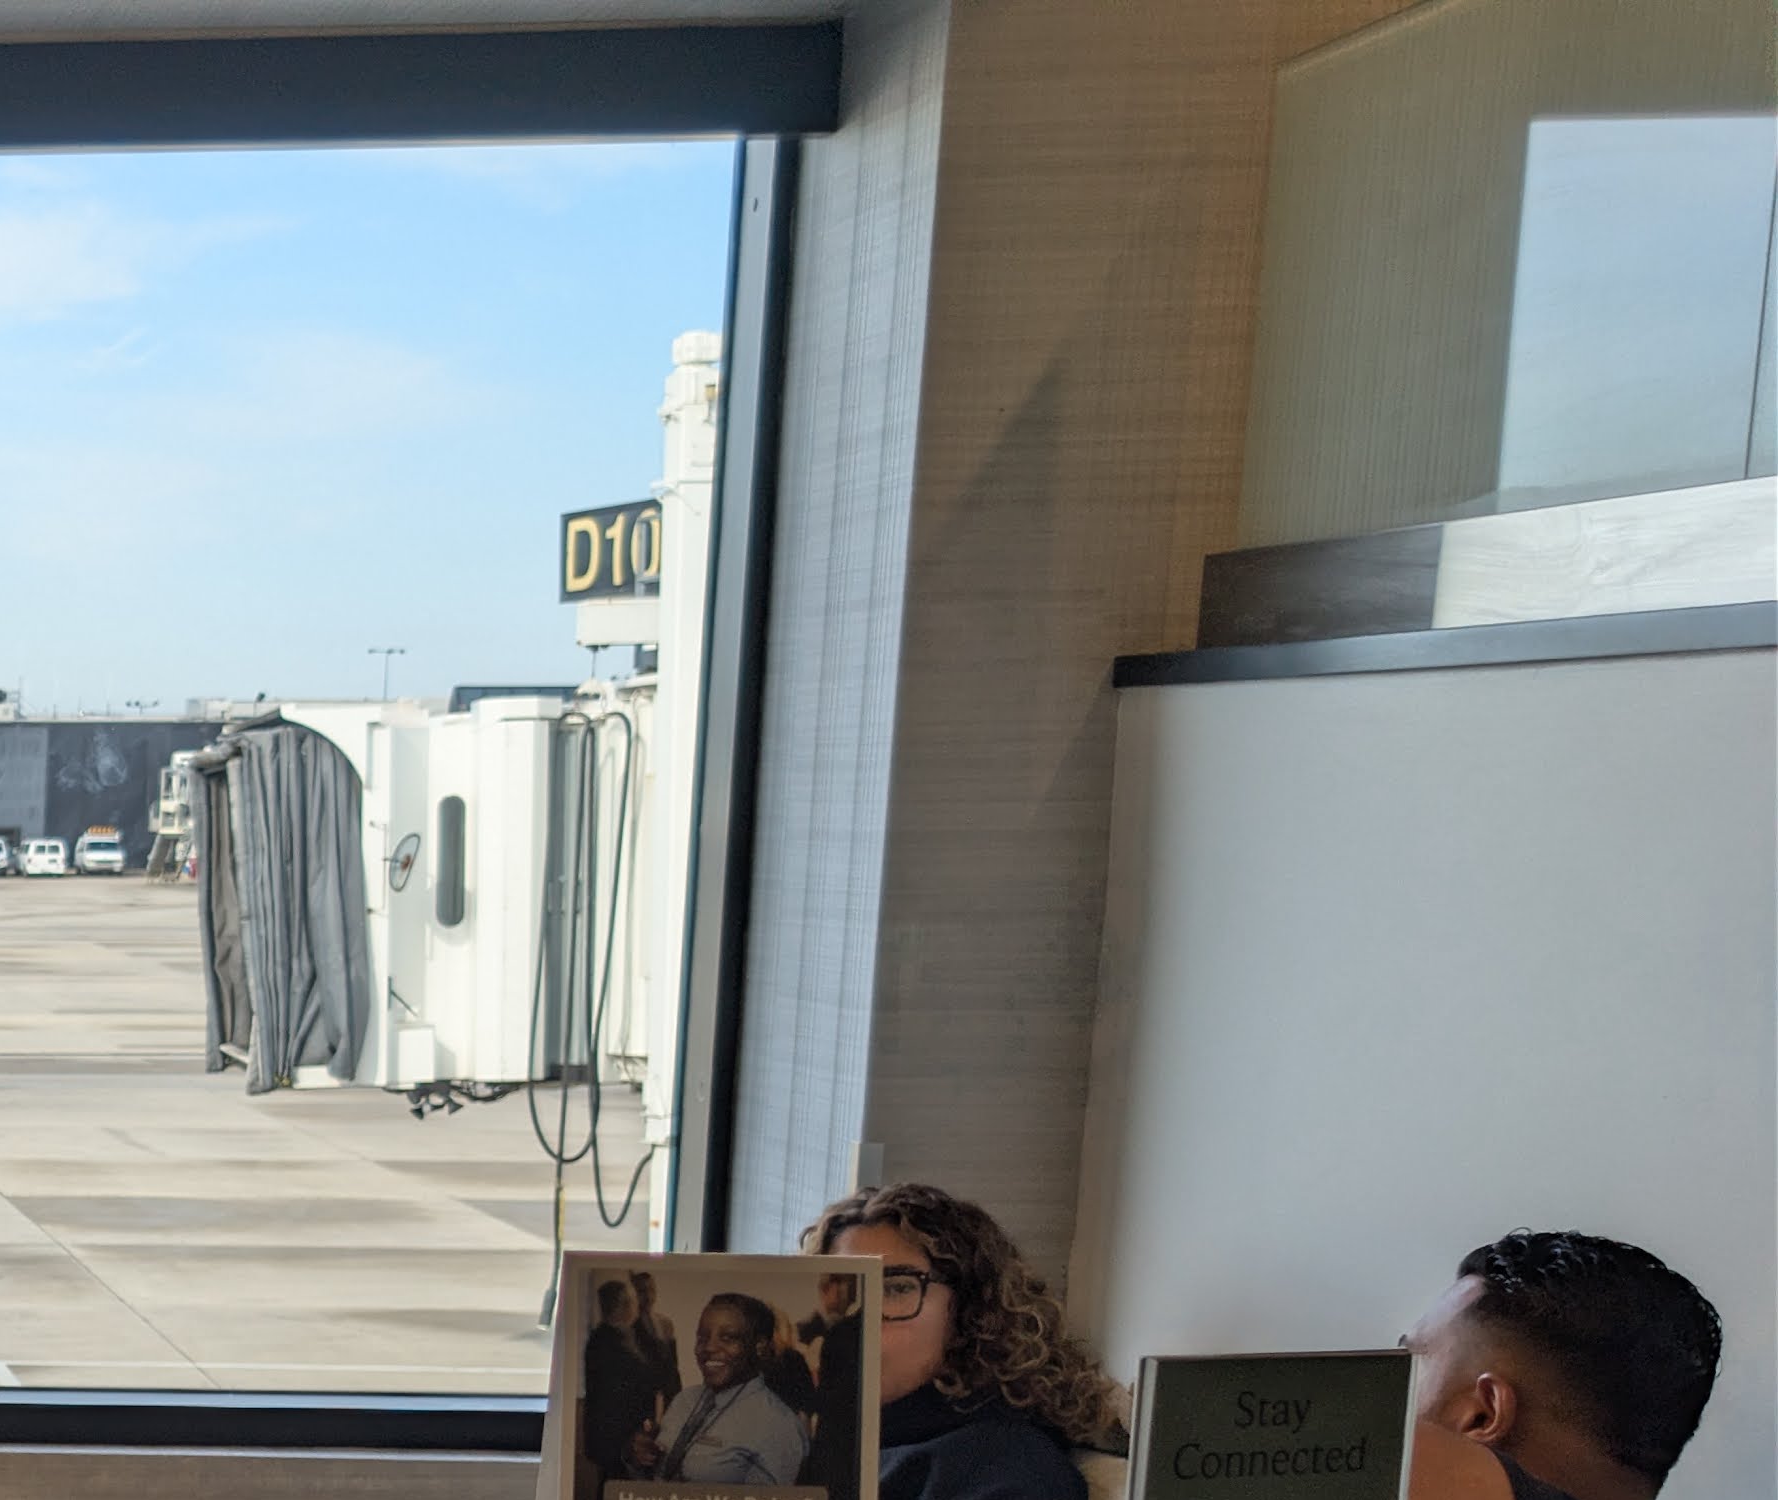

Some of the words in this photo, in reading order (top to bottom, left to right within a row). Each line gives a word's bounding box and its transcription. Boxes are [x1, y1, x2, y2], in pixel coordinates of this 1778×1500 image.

[565, 507, 661, 592] D10
[1234, 1391, 1313, 1434] Stay
[1174, 1437, 1368, 1480] Connected
